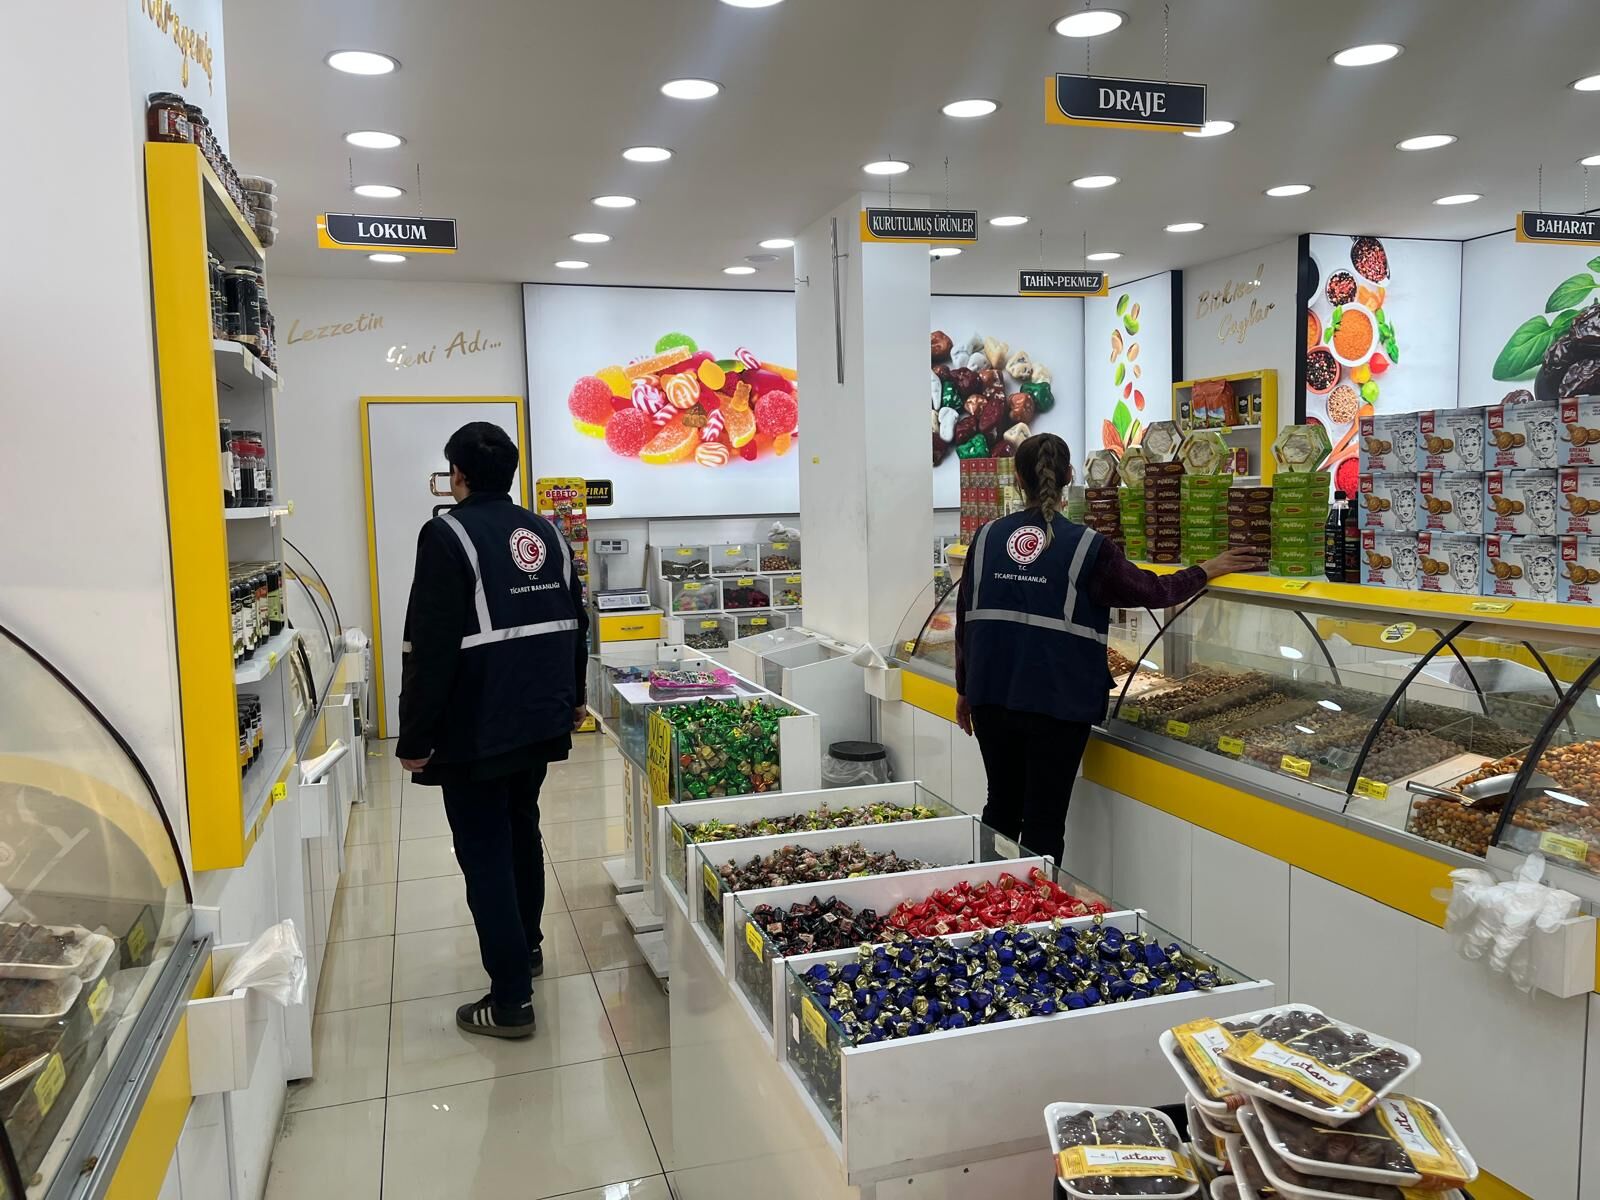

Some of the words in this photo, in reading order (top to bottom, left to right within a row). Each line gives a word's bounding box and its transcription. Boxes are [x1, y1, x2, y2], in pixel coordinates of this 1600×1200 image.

[1098, 88, 1166, 117] DRAJE
[357, 222, 427, 240] LOKUM
[872, 215, 932, 235] KURUTULMUŞ
[934, 213, 974, 233] ÜRÜNLER
[1536, 219, 1596, 235] BAHARAT
[1023, 272, 1099, 288] TAHİN-PEKMEZ
[287, 312, 385, 345] Lezzetin
[545, 489, 578, 498] BEBETO
[586, 487, 609, 496] FIRAT
[994, 572, 1018, 581] TİCARET
[1018, 574, 1048, 584] BAKANLIĞI
[510, 585, 530, 595] TİCARET
[531, 582, 560, 592] BAKANLIĞI
